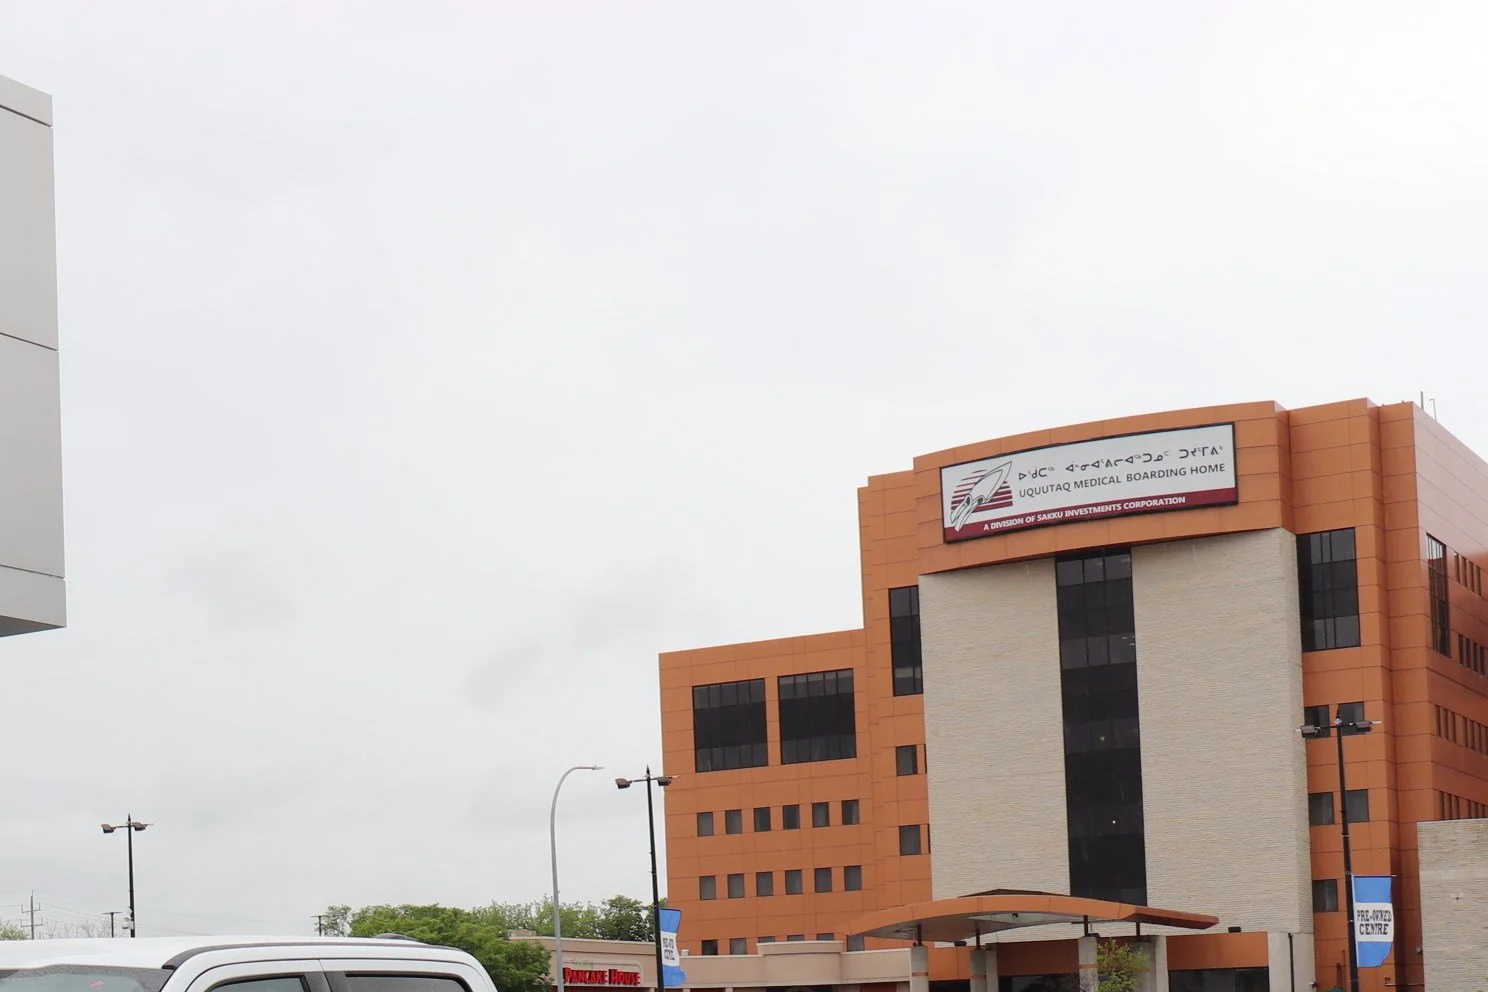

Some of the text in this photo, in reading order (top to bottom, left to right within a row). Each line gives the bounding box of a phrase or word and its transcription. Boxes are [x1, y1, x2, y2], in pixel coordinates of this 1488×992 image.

[1019, 463, 1226, 498] UQUUTAQ MEDICAL BOARDING HOME
[983, 496, 1186, 531] A DIVISION OF SAKKU INVESTMENTS CORPORATION
[1356, 910, 1392, 923] PRE-OWNED
[1359, 923, 1389, 935] CENTRE
[564, 967, 641, 986] PANCAKE HOUSE
